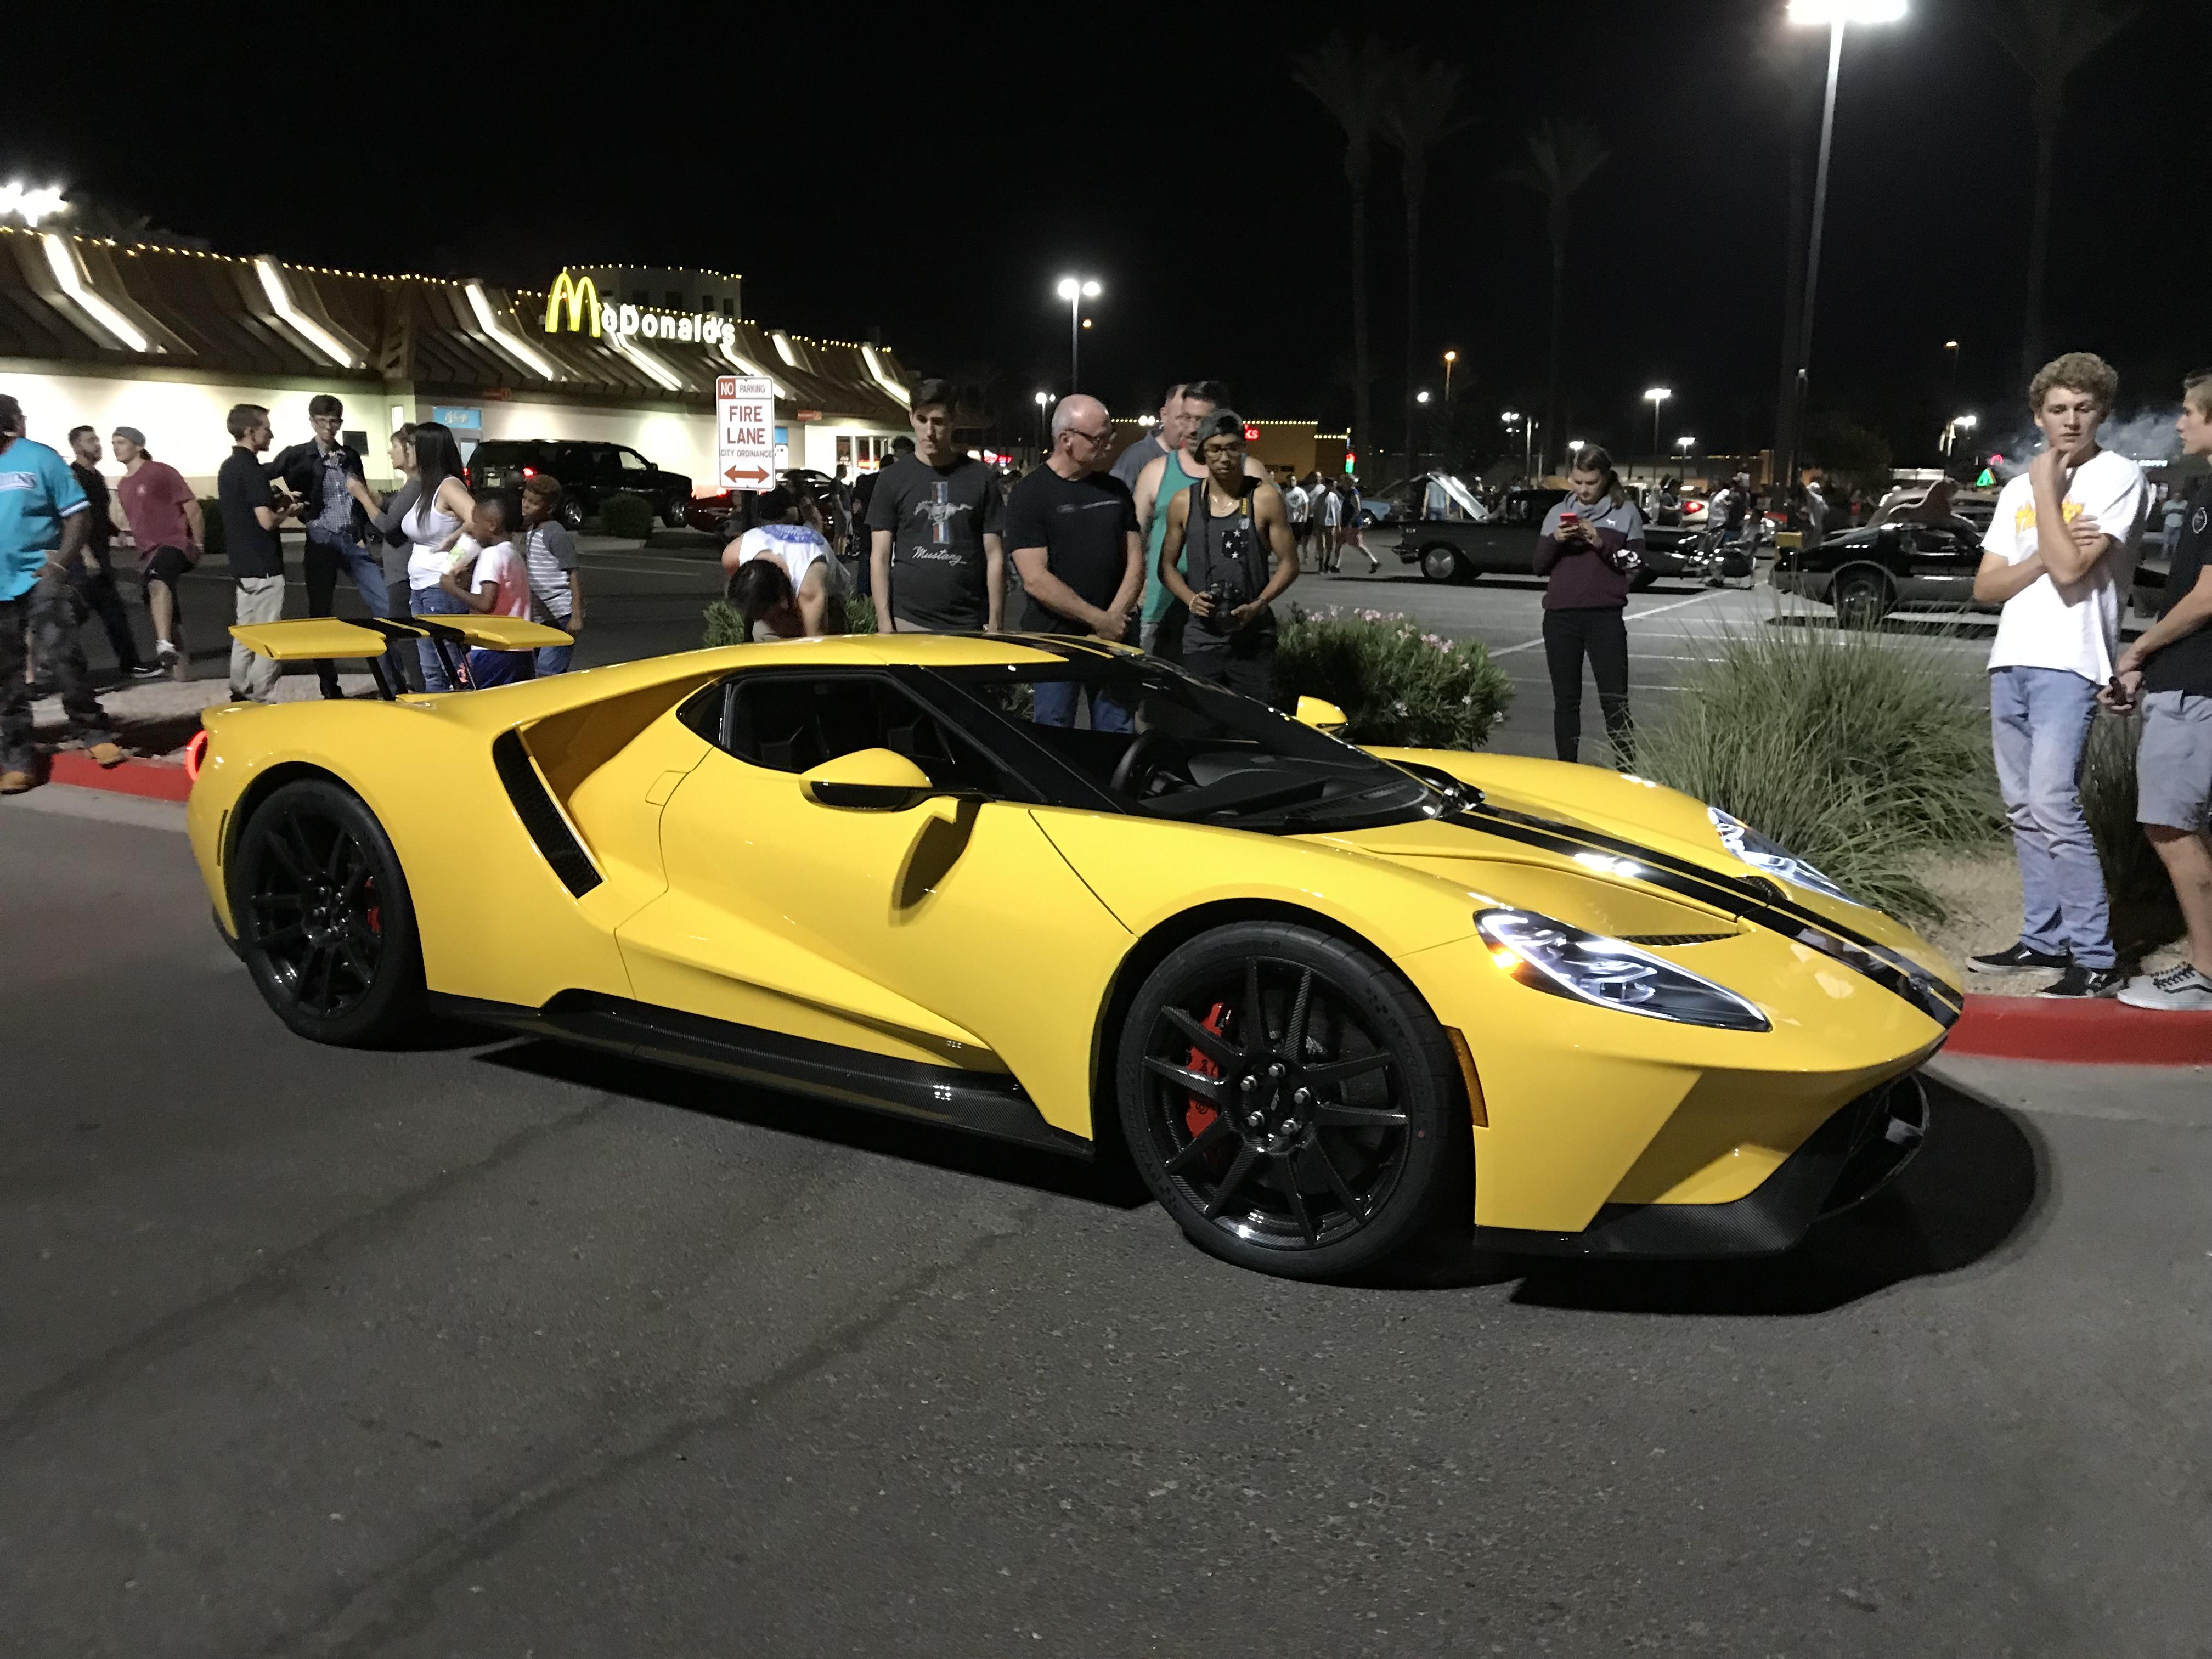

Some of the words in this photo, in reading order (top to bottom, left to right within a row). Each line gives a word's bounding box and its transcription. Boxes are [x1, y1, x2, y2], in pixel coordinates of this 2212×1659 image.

[545, 273, 736, 347] McDonald's
[720, 382, 734, 396] NO
[740, 385, 765, 393] PARKING
[729, 405, 763, 422] FIRE
[727, 427, 765, 444] LANE
[737, 449, 772, 458] ORDINANCE
[912, 546, 967, 566] Mustang
